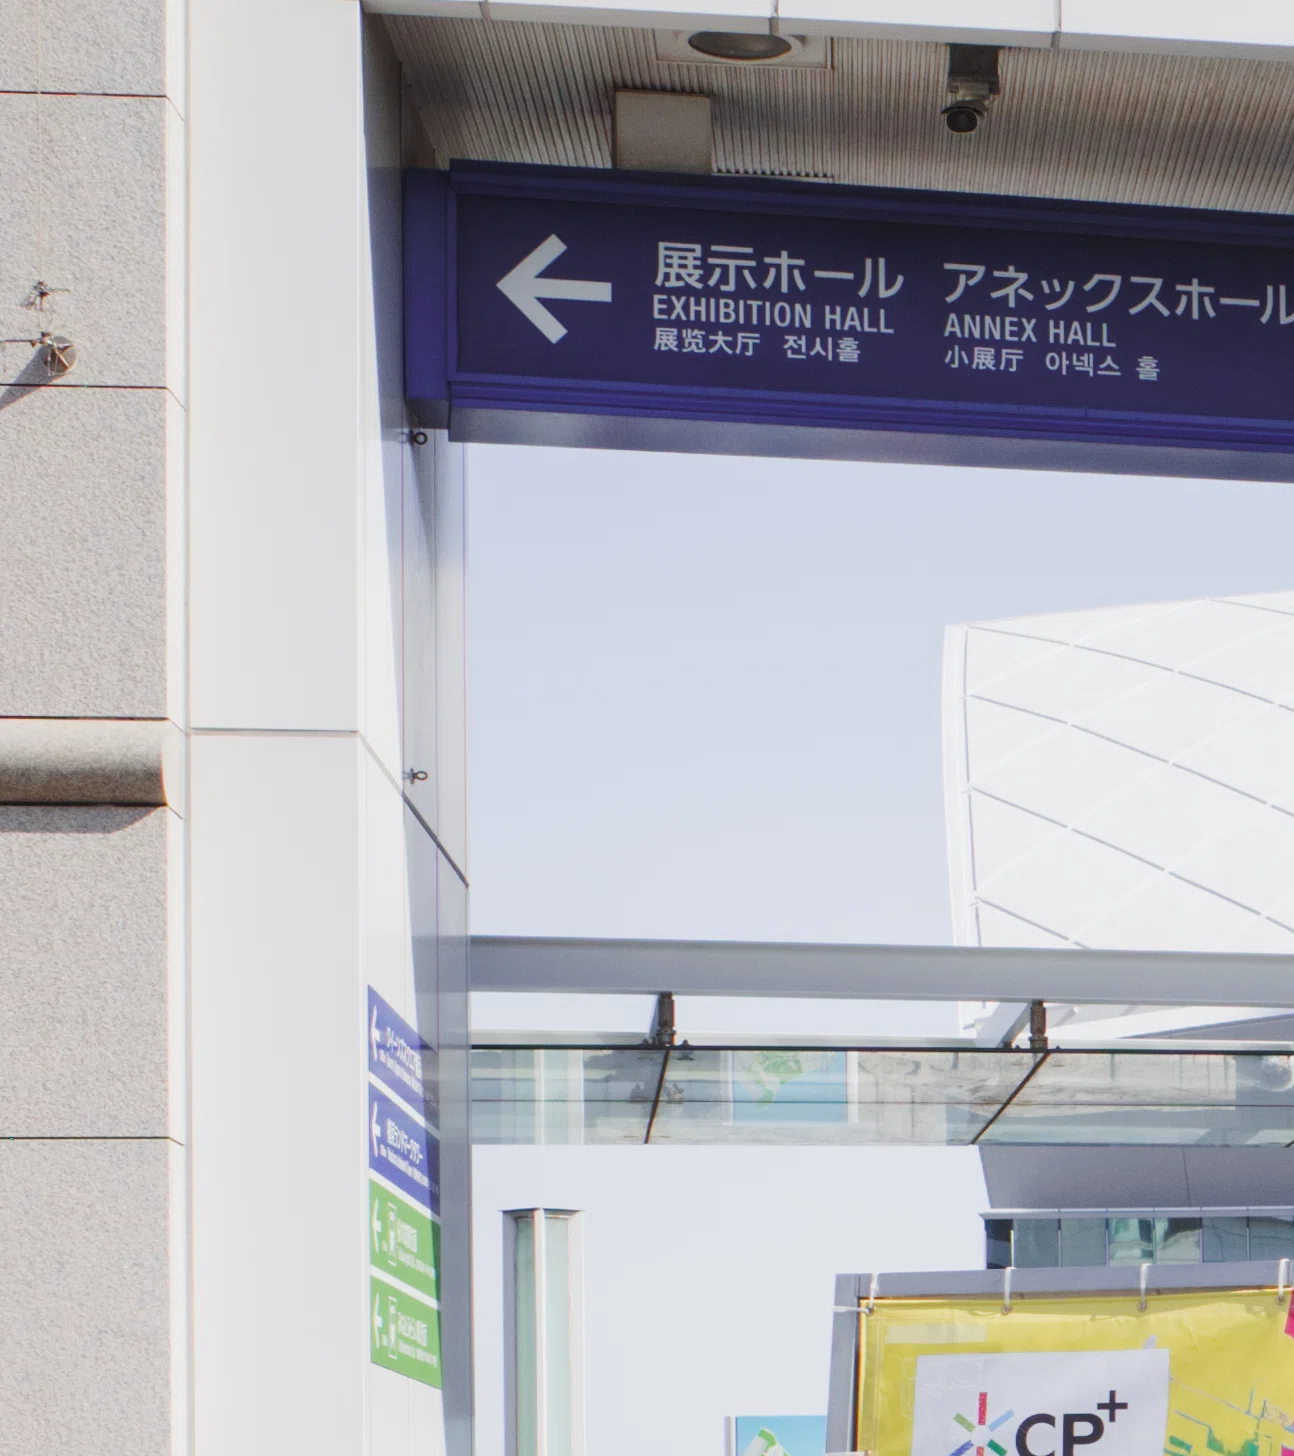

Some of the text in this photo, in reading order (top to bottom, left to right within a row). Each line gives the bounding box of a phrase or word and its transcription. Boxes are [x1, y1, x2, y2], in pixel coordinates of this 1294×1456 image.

[655, 241, 904, 299] 展示ホール
[652, 294, 894, 334] EXHIBITION HALL
[944, 313, 1116, 348] ANNEX HALL
[654, 327, 861, 363] 展览大厅 전시홀
[945, 345, 1160, 381] 小展厅 아넥스 홀
